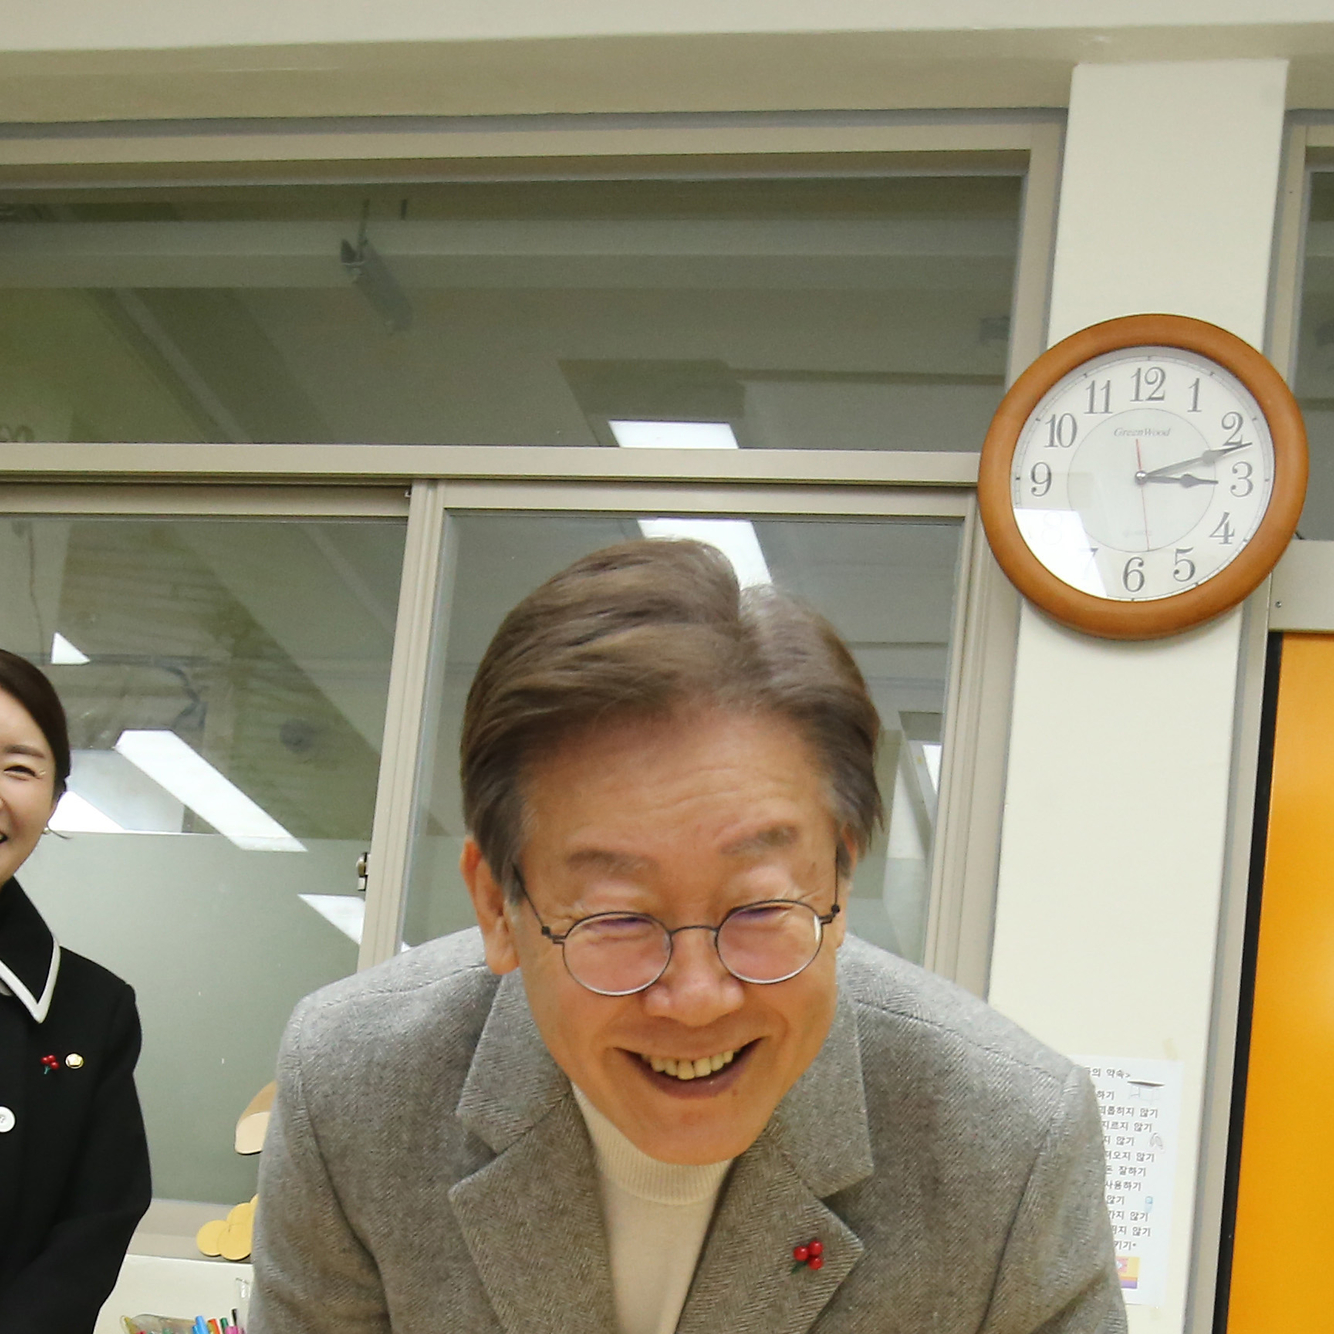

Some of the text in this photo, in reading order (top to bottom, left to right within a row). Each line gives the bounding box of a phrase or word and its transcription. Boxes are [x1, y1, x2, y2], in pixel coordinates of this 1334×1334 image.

[1083, 379, 1114, 414] 11
[1129, 366, 1167, 402] 12
[1187, 378, 1202, 413] 1
[1044, 412, 1078, 448] 10
[1221, 411, 1244, 447] 2
[1030, 461, 1052, 497] 9
[1230, 461, 1254, 498] 3
[1209, 511, 1235, 545] 4
[1122, 556, 1146, 593] 6
[1173, 546, 1196, 582] 5
[1133, 1122, 1153, 1133] 않기
[1139, 1108, 1158, 1119] 않기
[1116, 1136, 1135, 1147] 않기
[1136, 1152, 1155, 1163] 않기
[1118, 1165, 1147, 1177] 잘하기
[1106, 1195, 1125, 1206] 않기
[1130, 1211, 1149, 1222] 않기
[1132, 1226, 1151, 1237] 않기
